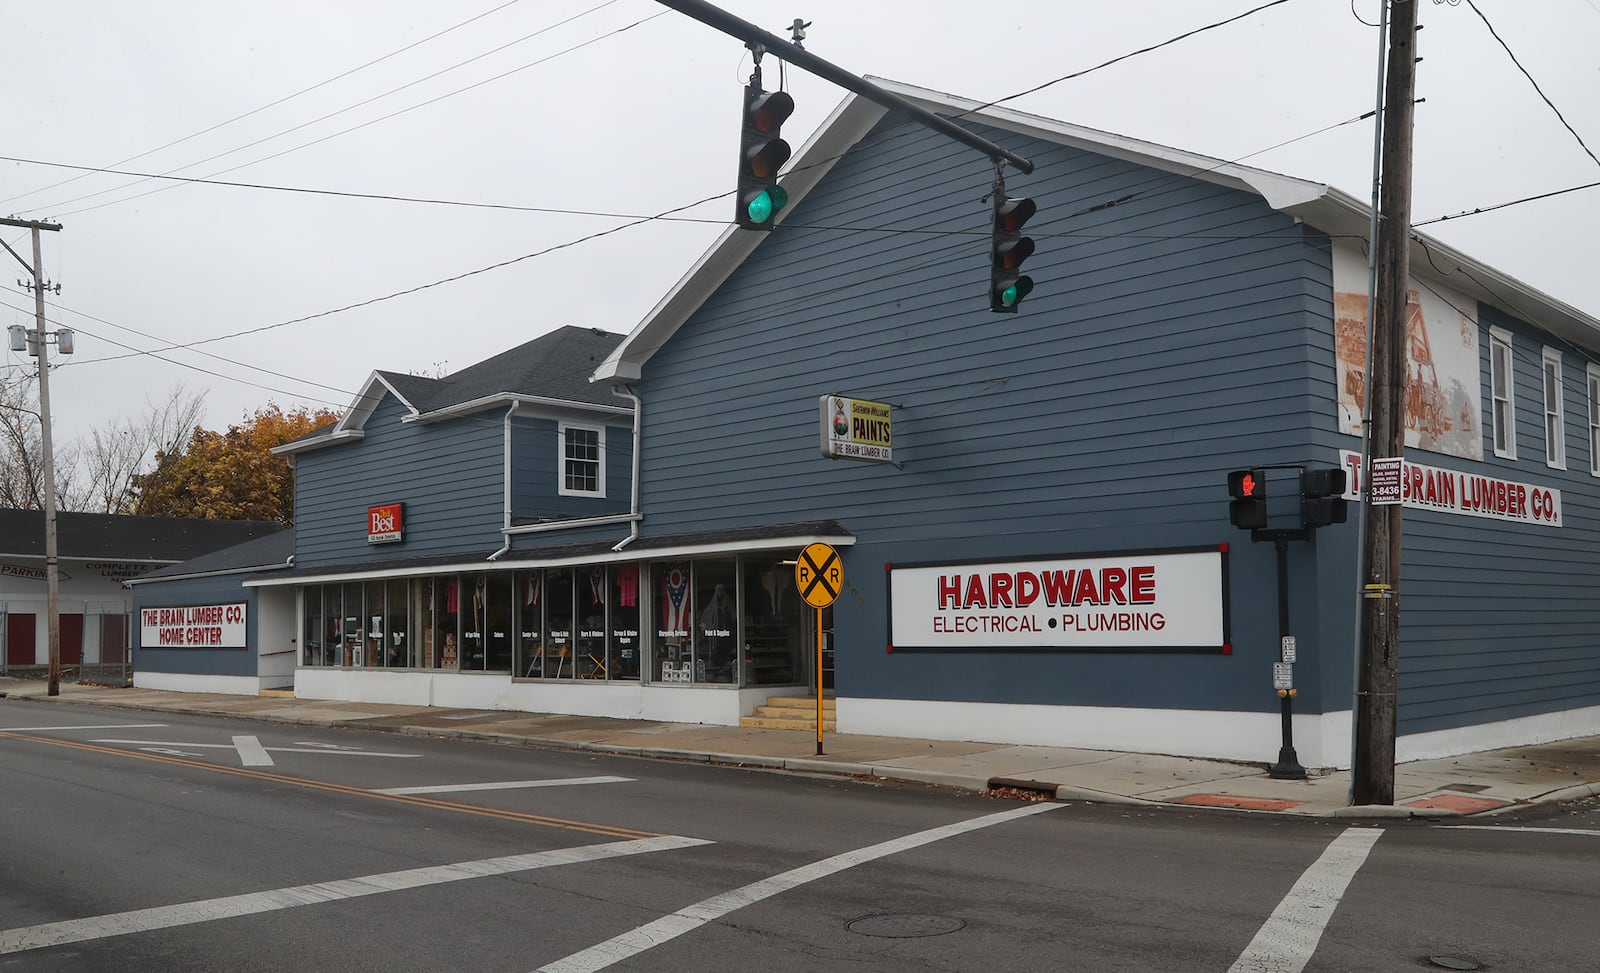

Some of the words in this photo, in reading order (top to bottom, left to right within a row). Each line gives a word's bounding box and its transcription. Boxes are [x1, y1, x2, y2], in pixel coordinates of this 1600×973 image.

[853, 417, 890, 443] PAINTS
[834, 443, 843, 454] THE
[845, 444, 860, 456] BRAIN
[861, 446, 880, 458] LUMBER
[1374, 462, 1400, 471] PAINTING
[1461, 474, 1528, 519] LUMBER
[1532, 487, 1558, 522] CO.
[371, 513, 395, 533] Best
[86, 562, 149, 571] COMPLETE
[800, 567, 809, 583] R
[830, 568, 839, 583] R
[937, 565, 1156, 610] HARDWARE
[143, 610, 158, 626] THE
[160, 608, 185, 626] BRAIN
[187, 606, 223, 626] LUMBER
[226, 605, 244, 624] CO.
[933, 614, 1042, 633] ELECTRICAL
[1063, 612, 1166, 632] PLUMBING
[160, 628, 184, 645] HOME
[186, 627, 222, 645] CENTER
